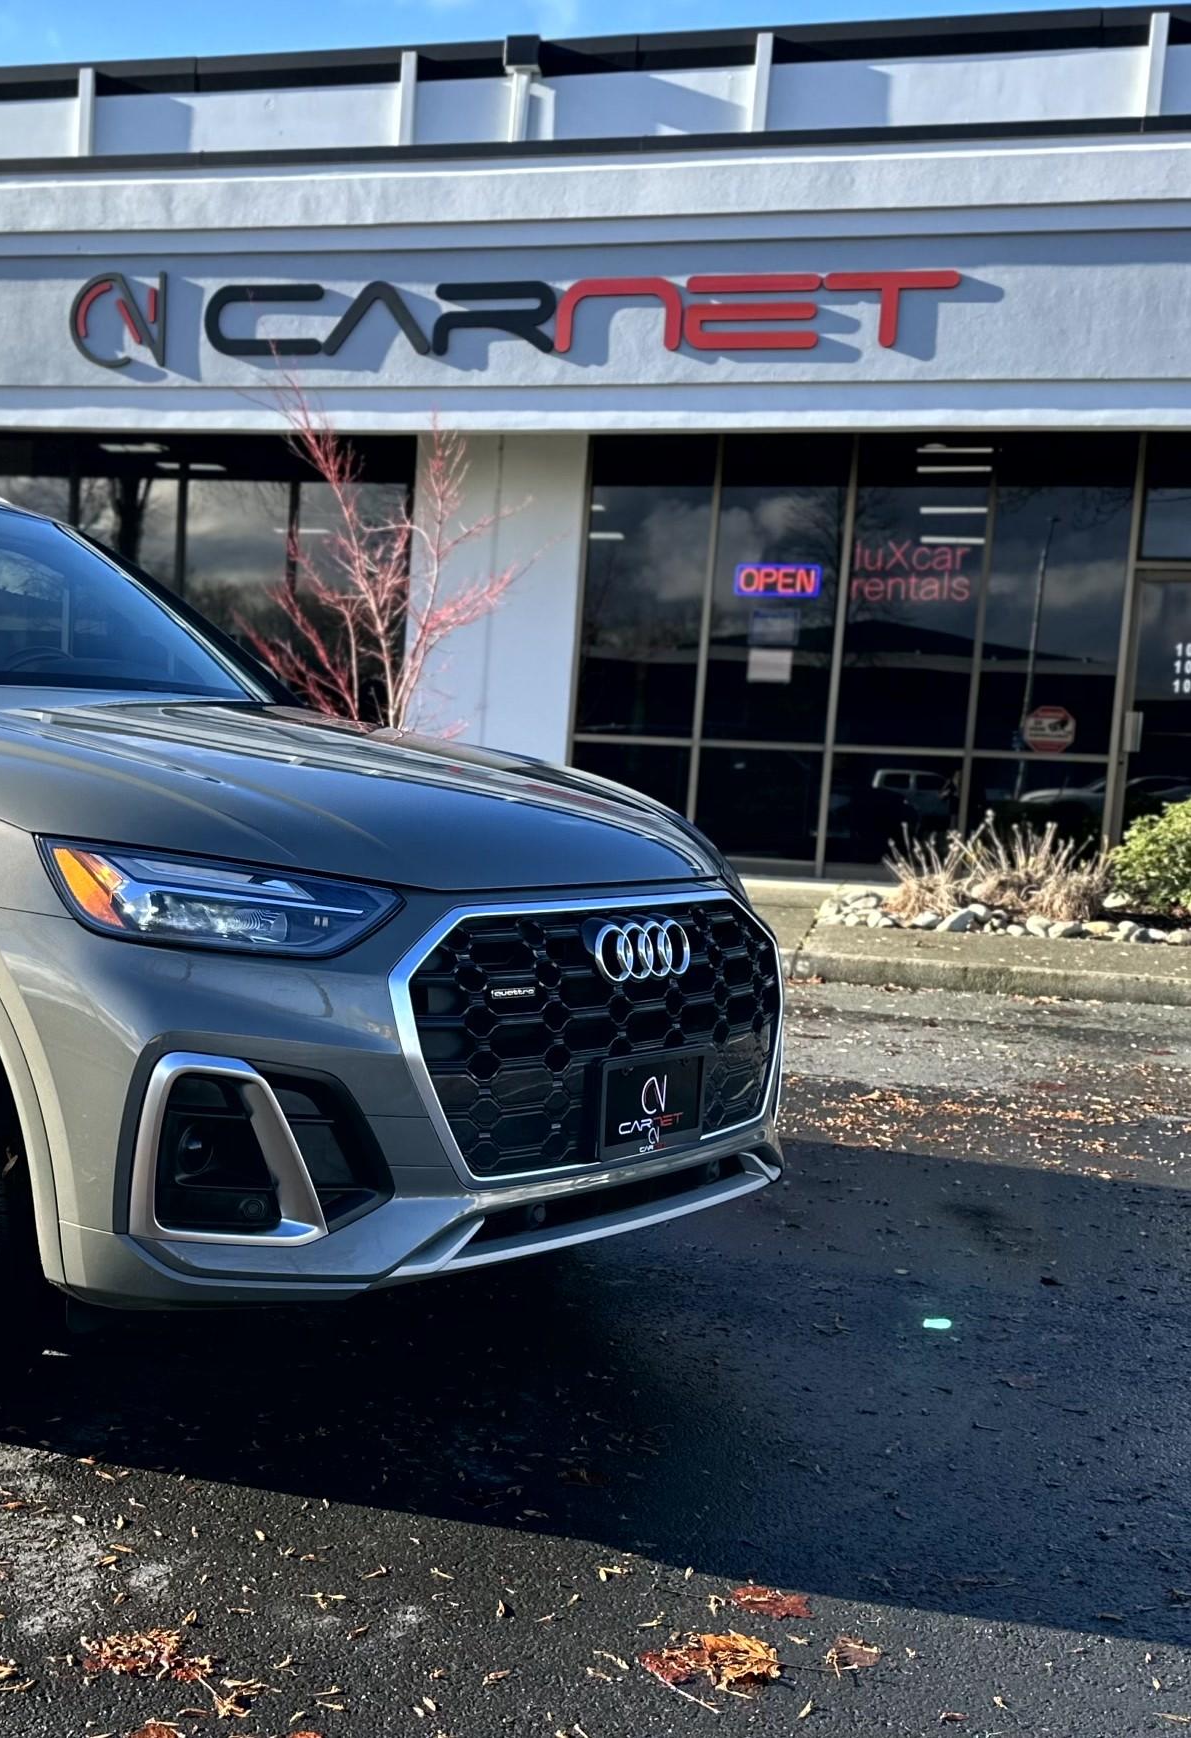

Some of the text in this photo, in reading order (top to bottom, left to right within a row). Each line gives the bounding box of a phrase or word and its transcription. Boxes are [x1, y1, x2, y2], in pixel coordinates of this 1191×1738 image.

[204, 270, 961, 357] CARNET
[740, 567, 816, 593] OPEN
[851, 571, 970, 601] rentals
